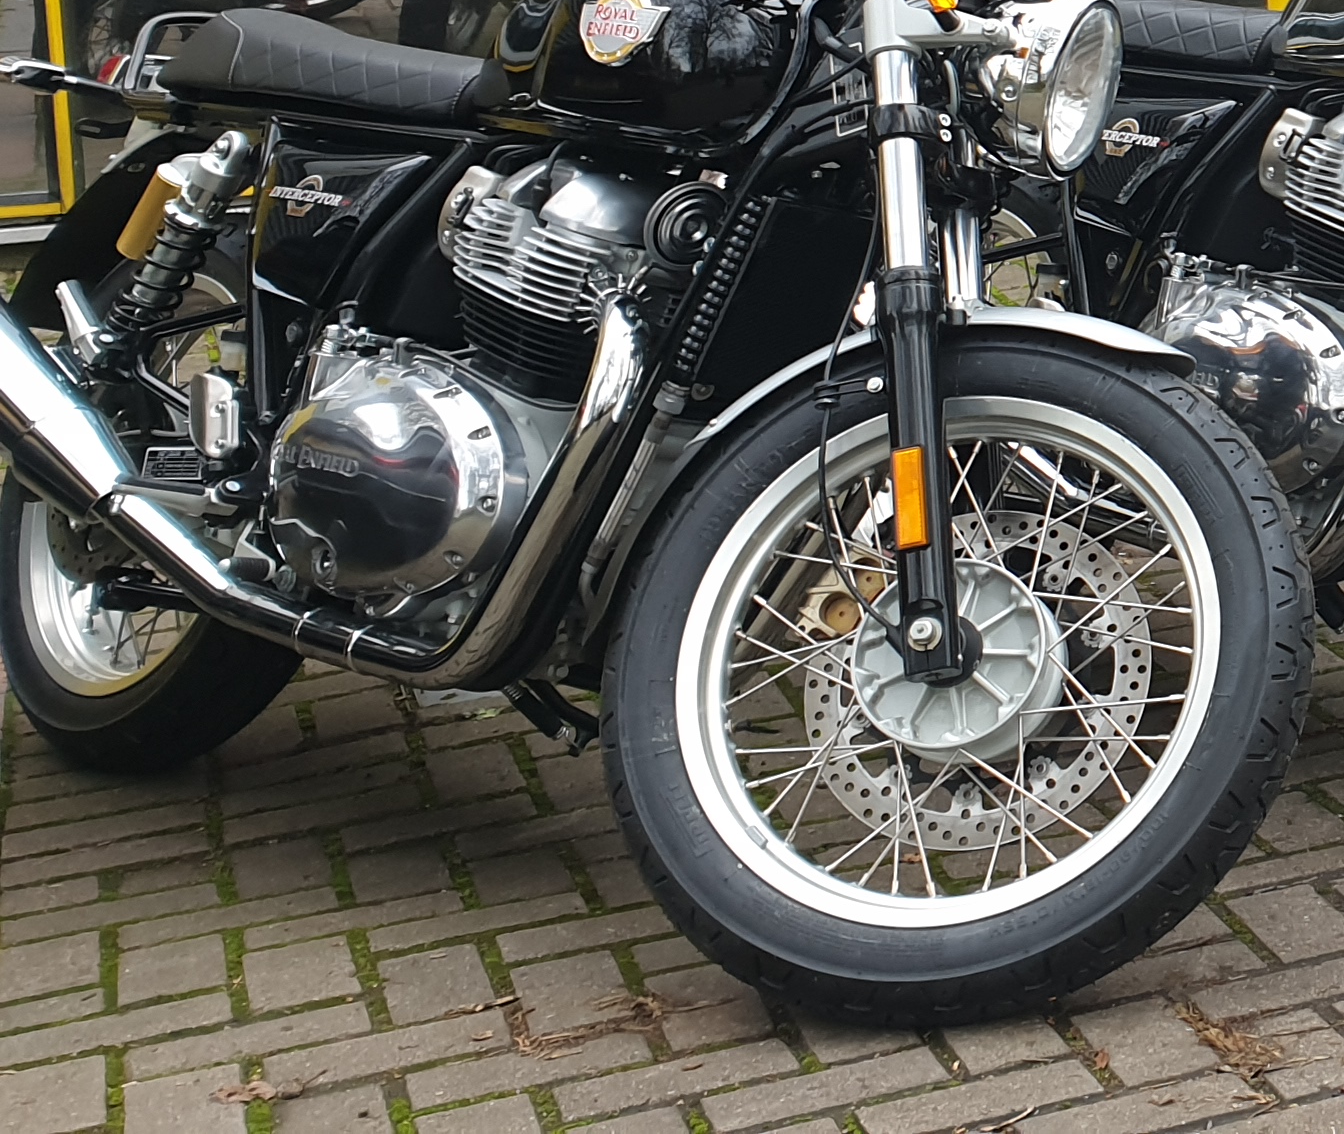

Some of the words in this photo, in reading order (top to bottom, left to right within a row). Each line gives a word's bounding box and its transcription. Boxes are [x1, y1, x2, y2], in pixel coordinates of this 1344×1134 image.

[594, 4, 637, 22] ROYAL
[586, 21, 640, 40] ENFIELD
[1101, 129, 1161, 148] ERCEPTOR
[269, 186, 343, 206] INTERCEPTOR
